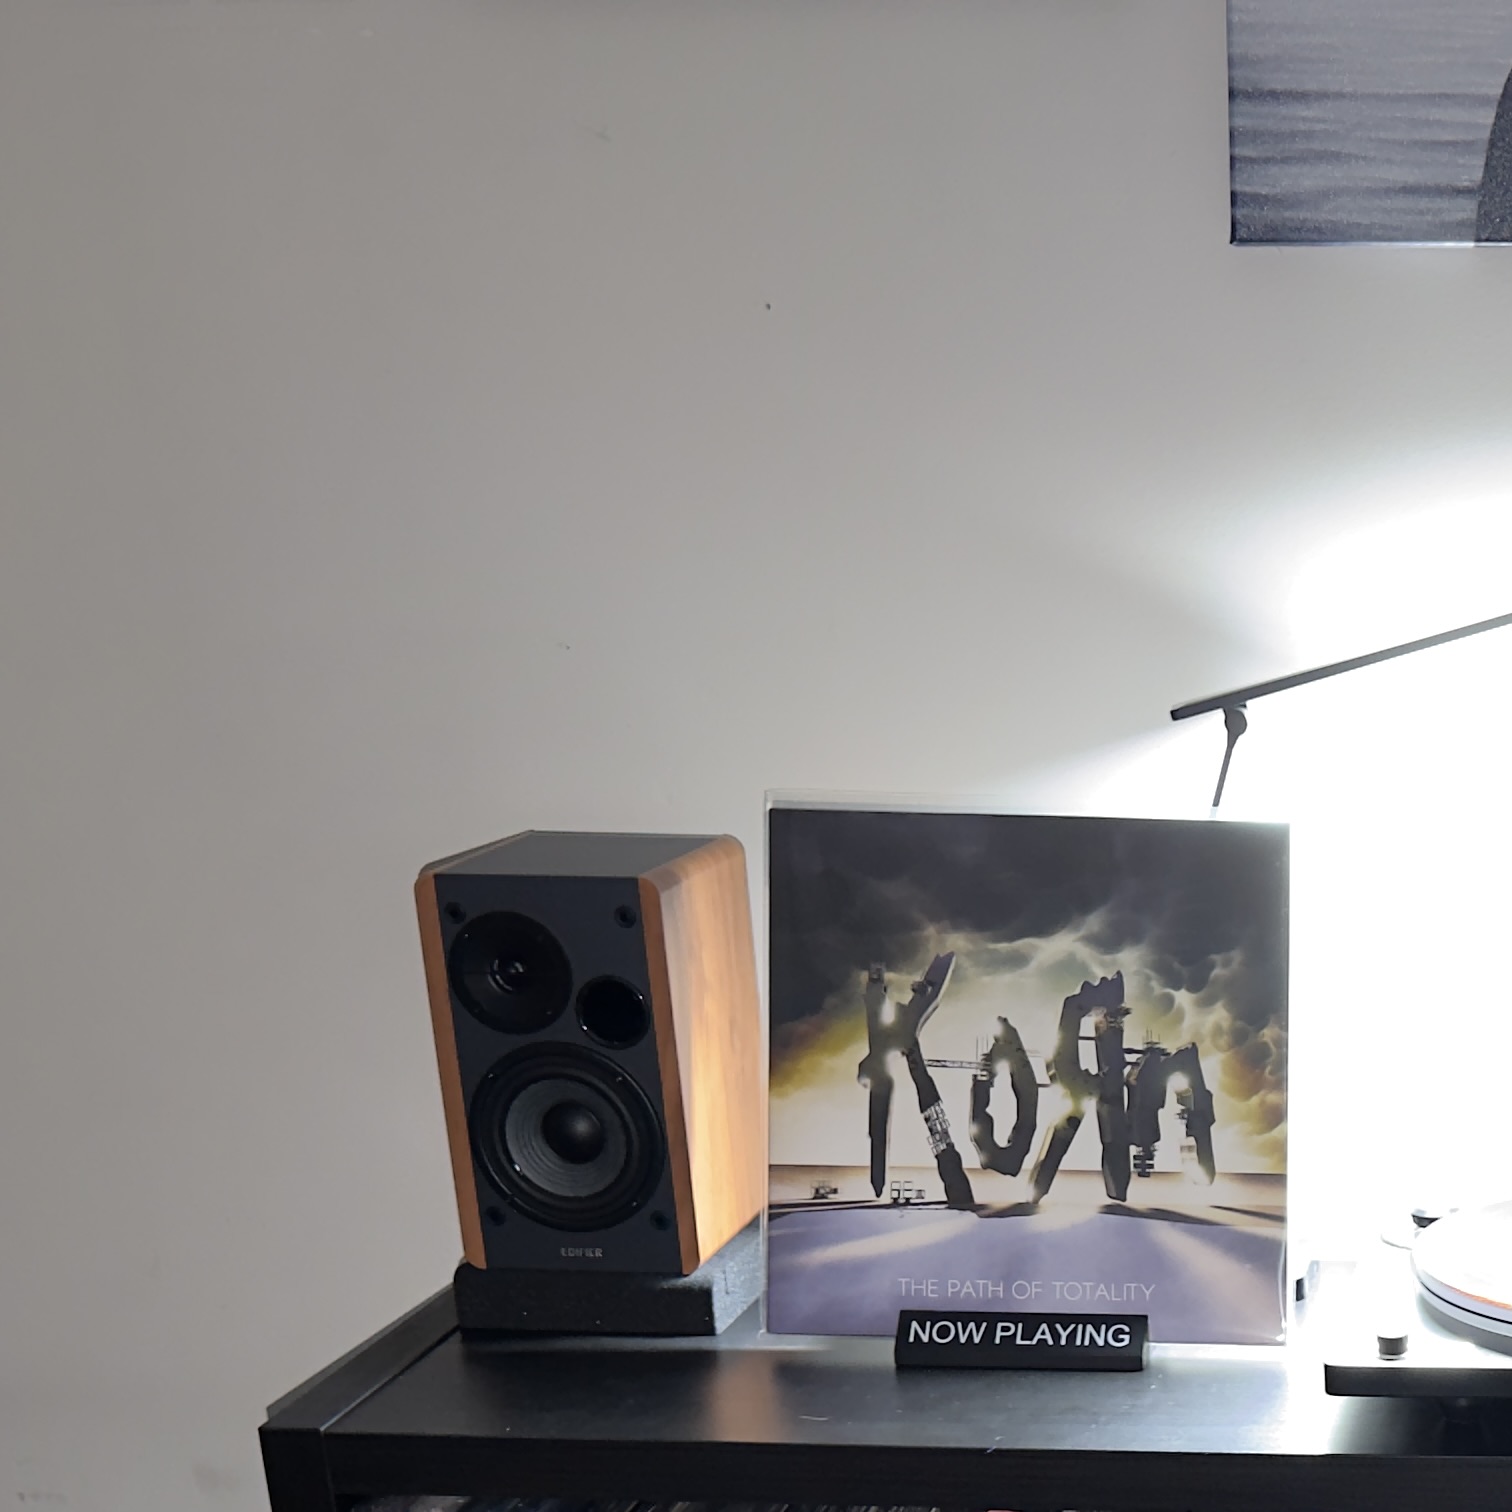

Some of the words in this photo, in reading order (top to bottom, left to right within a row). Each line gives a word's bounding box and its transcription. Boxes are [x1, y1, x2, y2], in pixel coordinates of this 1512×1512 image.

[897, 1278, 939, 1297] THE
[946, 1279, 1004, 1299] PATH
[1012, 1280, 1043, 1300] OF
[1052, 1281, 1156, 1301] TOTALITY
[908, 1320, 988, 1344] NOW
[993, 1322, 1131, 1347] PLAYING
